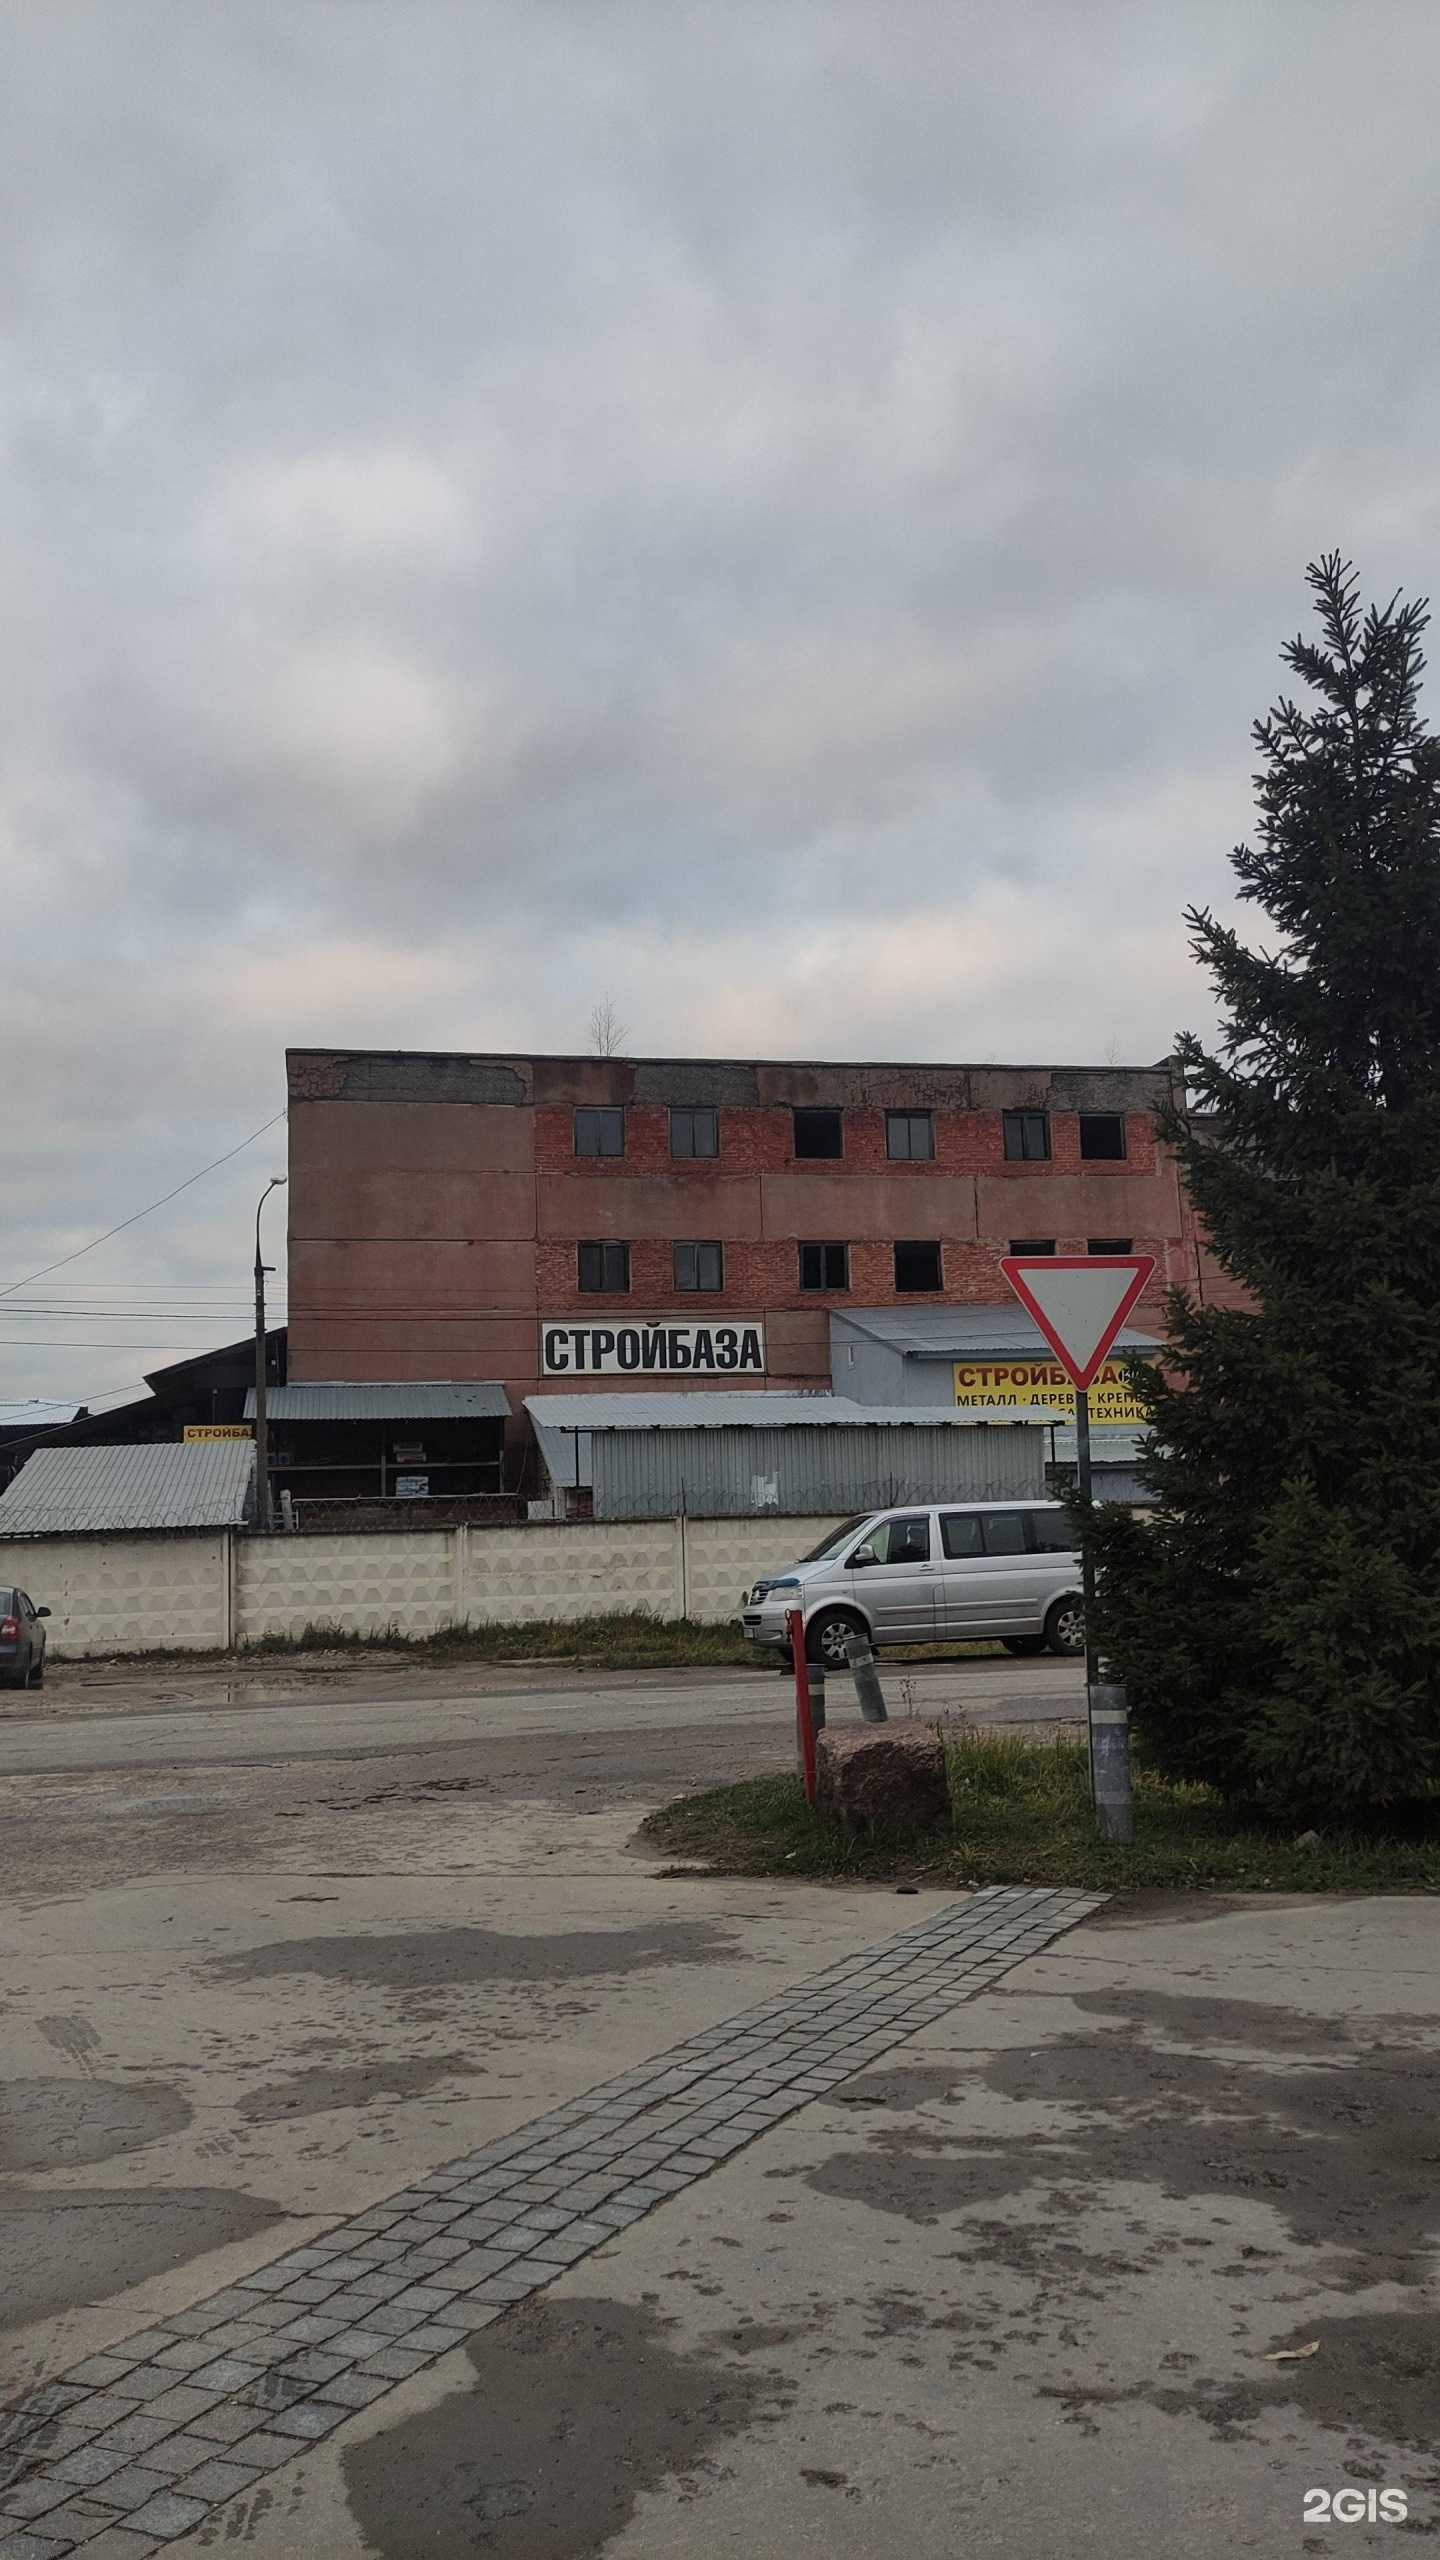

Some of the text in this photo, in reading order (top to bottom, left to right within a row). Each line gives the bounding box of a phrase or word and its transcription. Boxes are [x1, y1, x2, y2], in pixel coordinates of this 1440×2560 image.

[545, 1322, 762, 1370] СТРОЙБАЗА
[958, 1363, 1118, 1387] СТРОЙБА
[957, 1394, 1017, 1406] МЕТАЛЛ
[1030, 1393, 1074, 1406] ДЕРЕВ
[187, 1428, 250, 1438] СТРОЙБА
